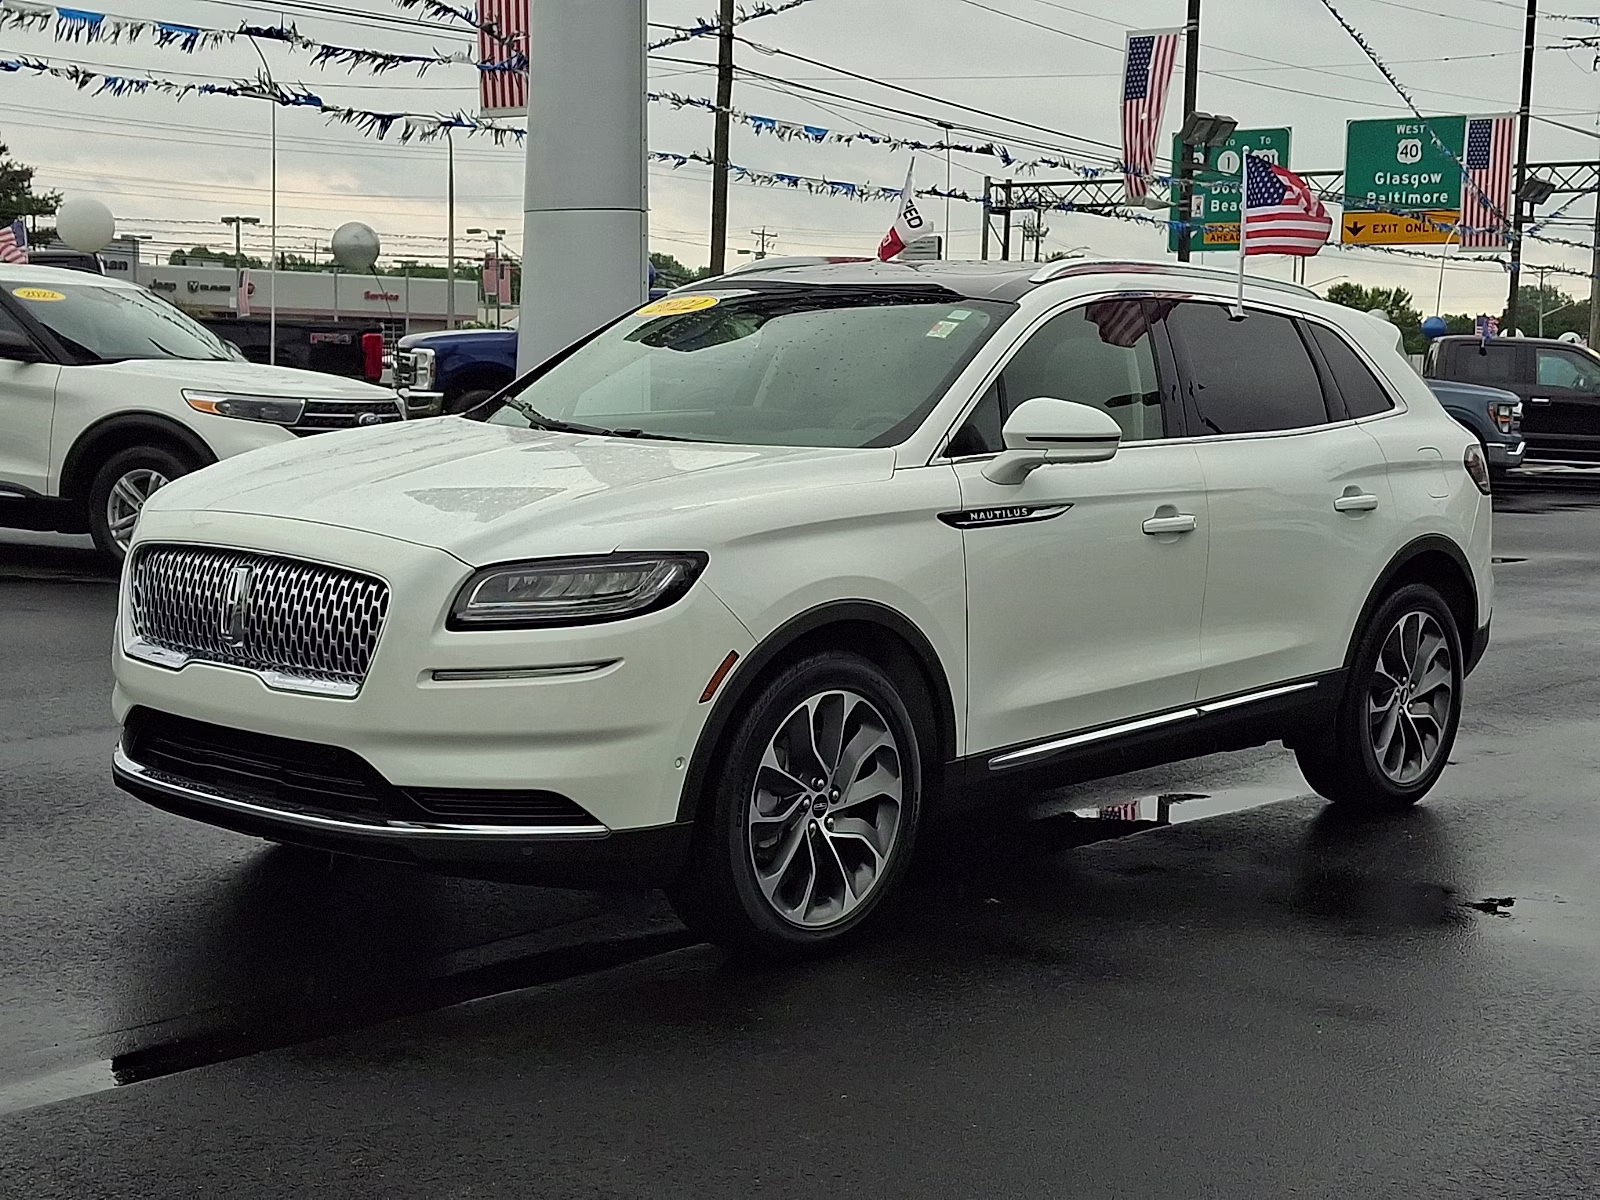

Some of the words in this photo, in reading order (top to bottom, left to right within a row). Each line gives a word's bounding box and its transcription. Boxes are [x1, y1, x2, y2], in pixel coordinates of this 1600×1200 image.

[1396, 124, 1426, 134] WEST
[1399, 144, 1419, 158] 40
[1374, 172, 1442, 189] Glasgow
[1366, 191, 1449, 204] Baltimore
[1372, 224, 1398, 233] EXIT
[364, 290, 399, 302] Service
[970, 507, 1028, 521] NAUTILUS
